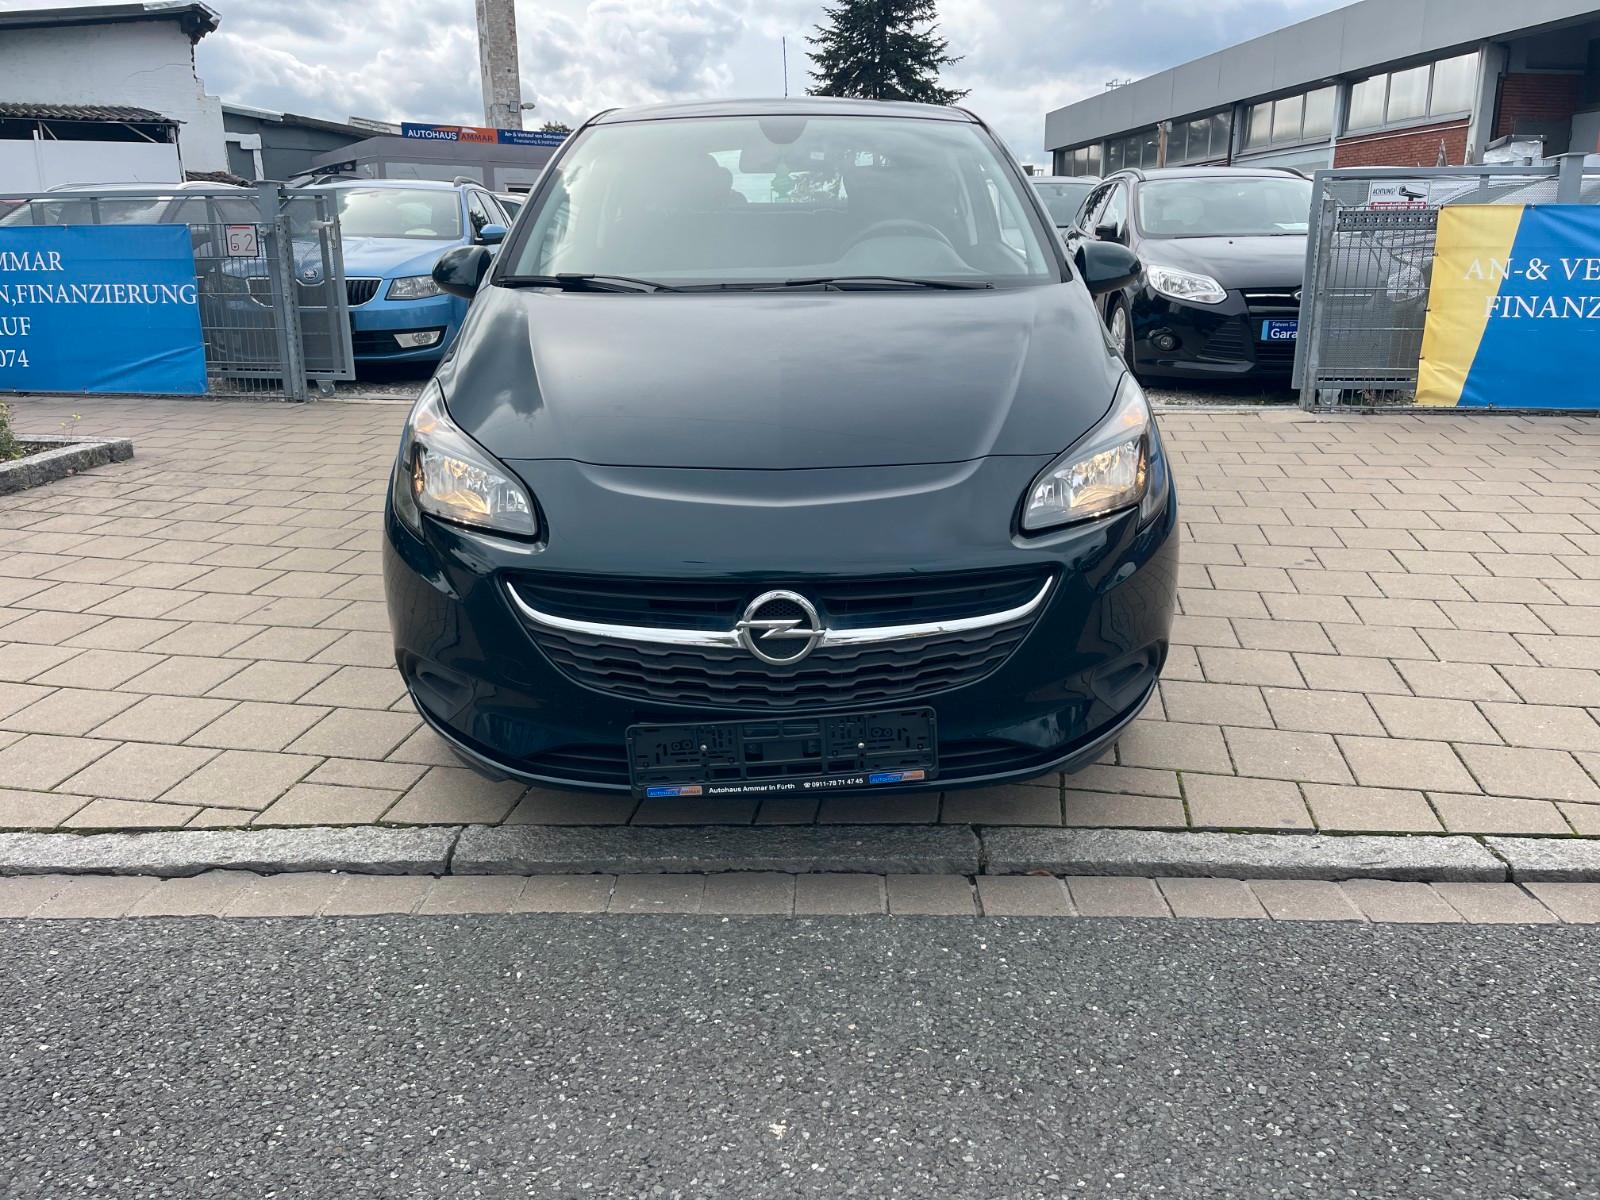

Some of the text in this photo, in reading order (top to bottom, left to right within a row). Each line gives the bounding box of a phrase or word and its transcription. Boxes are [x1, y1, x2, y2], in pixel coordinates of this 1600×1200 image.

[407, 129, 494, 143] AUTOHAUS AMMAR
[230, 233, 257, 252] 62
[1559, 257, 1600, 281] VE
[1484, 295, 1600, 319] FINANZ
[0, 316, 31, 336] UF
[708, 786, 742, 794] Autohaus
